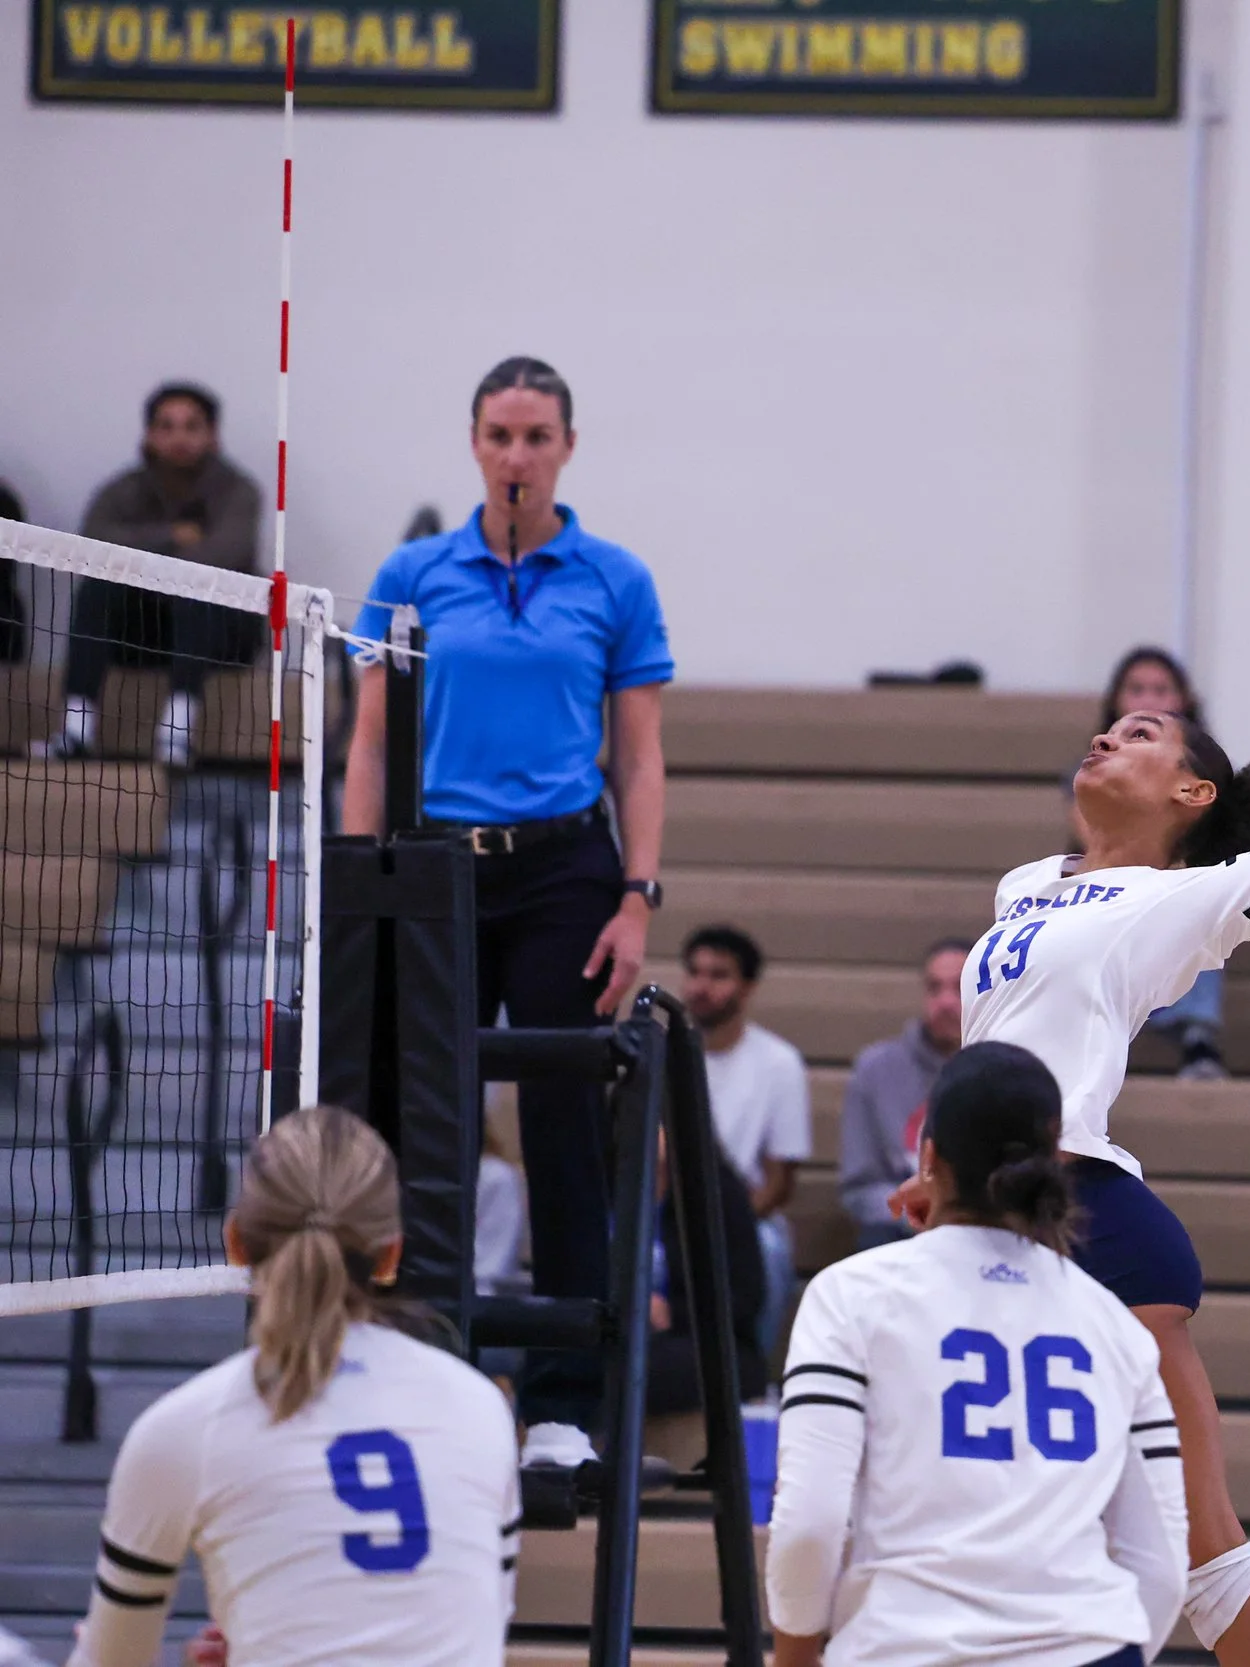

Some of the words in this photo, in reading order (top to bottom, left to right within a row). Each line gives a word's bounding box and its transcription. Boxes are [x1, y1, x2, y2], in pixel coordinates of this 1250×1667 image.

[64, 9, 471, 71] VOLLEYBALL
[681, 19, 1025, 79] SWIMMING
[977, 920, 1046, 995] 19
[941, 1328, 1098, 1462] 26
[326, 1429, 431, 1574] 9
